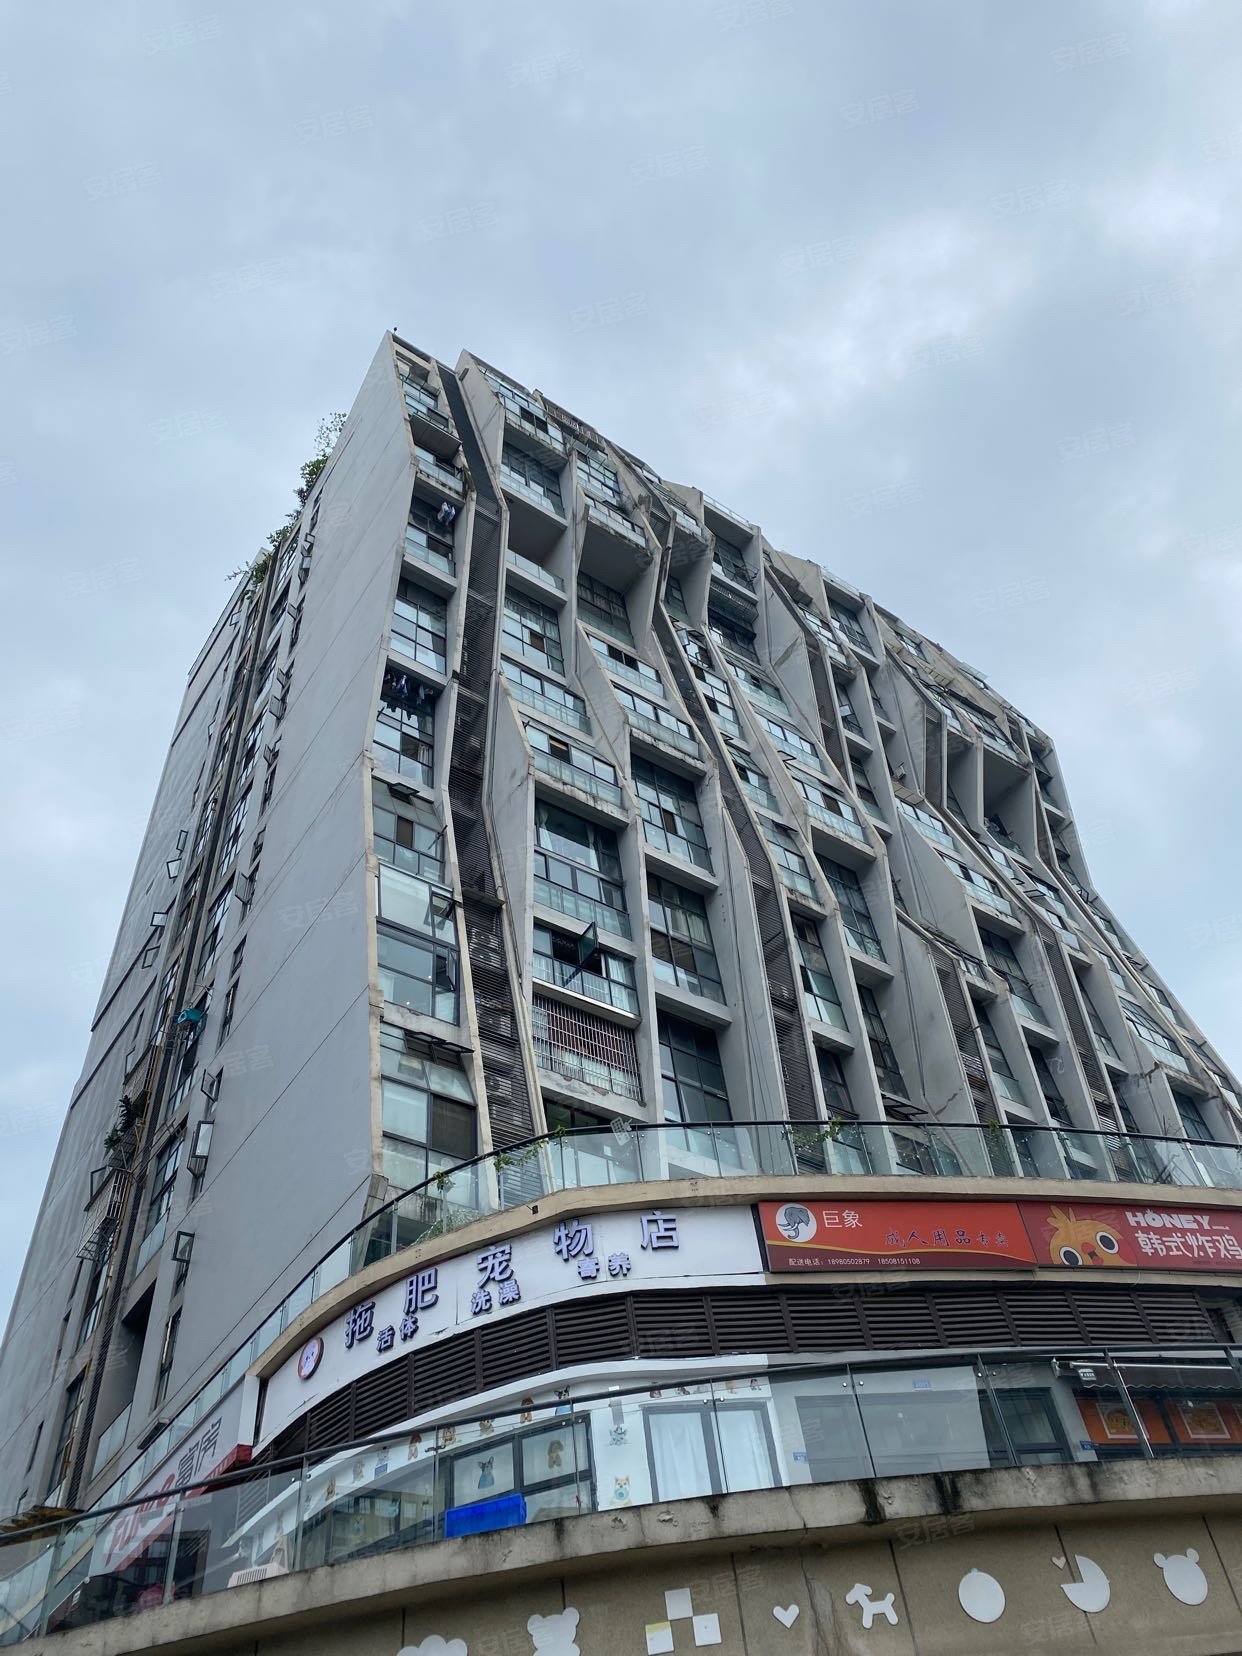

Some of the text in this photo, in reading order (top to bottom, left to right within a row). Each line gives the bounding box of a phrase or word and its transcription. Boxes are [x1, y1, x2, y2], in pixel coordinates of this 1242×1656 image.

[822, 1209, 863, 1229] 巨象
[1125, 1209, 1211, 1230] HONEY
[885, 1227, 1009, 1248] 成人用品专卖
[1135, 1230, 1242, 1260] 韩式炸鸡
[827, 1258, 870, 1266] 18980502879
[877, 1257, 921, 1266] 18508151108
[376, 1315, 419, 1353] 活体
[470, 1279, 521, 1316] 洗澡
